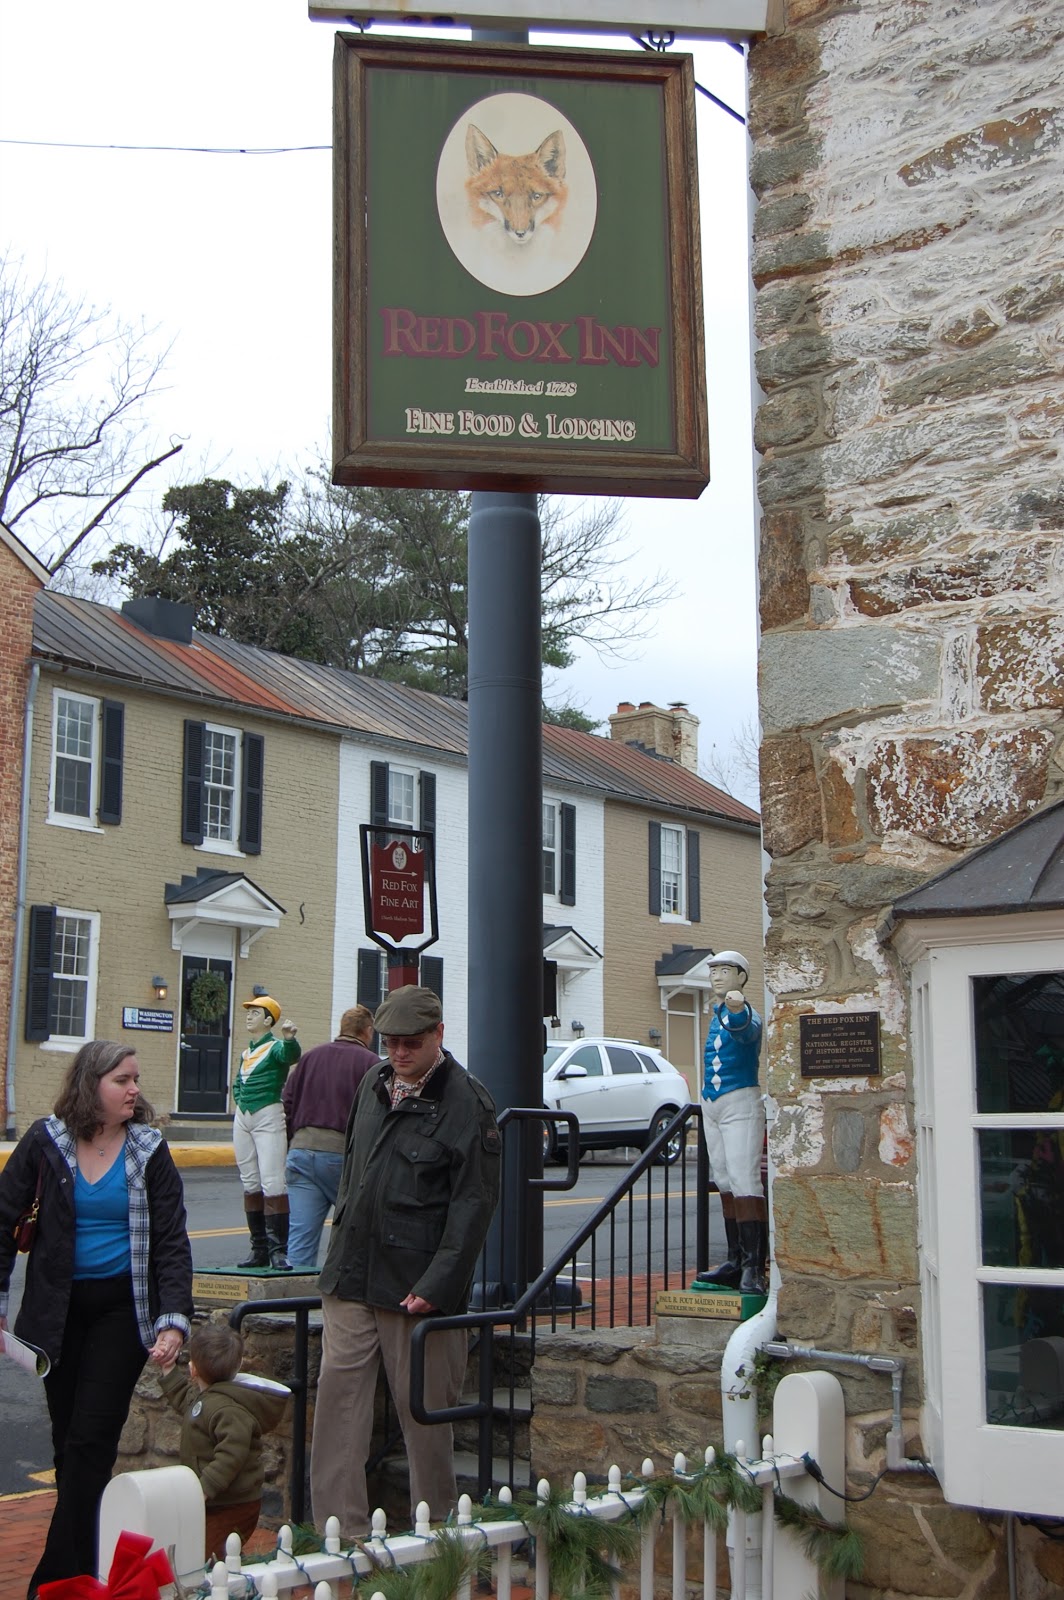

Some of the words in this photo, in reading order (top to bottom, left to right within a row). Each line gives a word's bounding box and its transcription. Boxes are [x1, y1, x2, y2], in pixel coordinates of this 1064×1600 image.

[575, 315, 661, 368] INN
[465, 377, 544, 395] Established
[545, 381, 577, 397] 1728
[405, 407, 455, 435] FINE
[457, 409, 516, 437] FOOD
[519, 412, 541, 438] &
[545, 413, 636, 441] LODGING
[382, 878, 400, 891] RED
[400, 880, 418, 892] FOX
[380, 895, 400, 907] FINE
[401, 897, 419, 909] ART
[139, 1011, 173, 1019] WASHINGTON
[840, 1016, 855, 1024] FOX
[855, 1015, 870, 1023] INN
[840, 1039, 872, 1047] REGISTER
[816, 1047, 846, 1055] HISTORIC
[659, 1295, 672, 1303] PAUL
[679, 1296, 694, 1305] FOUT
[694, 1298, 715, 1306] MAIDEN
[716, 1299, 739, 1308] HURDLE
